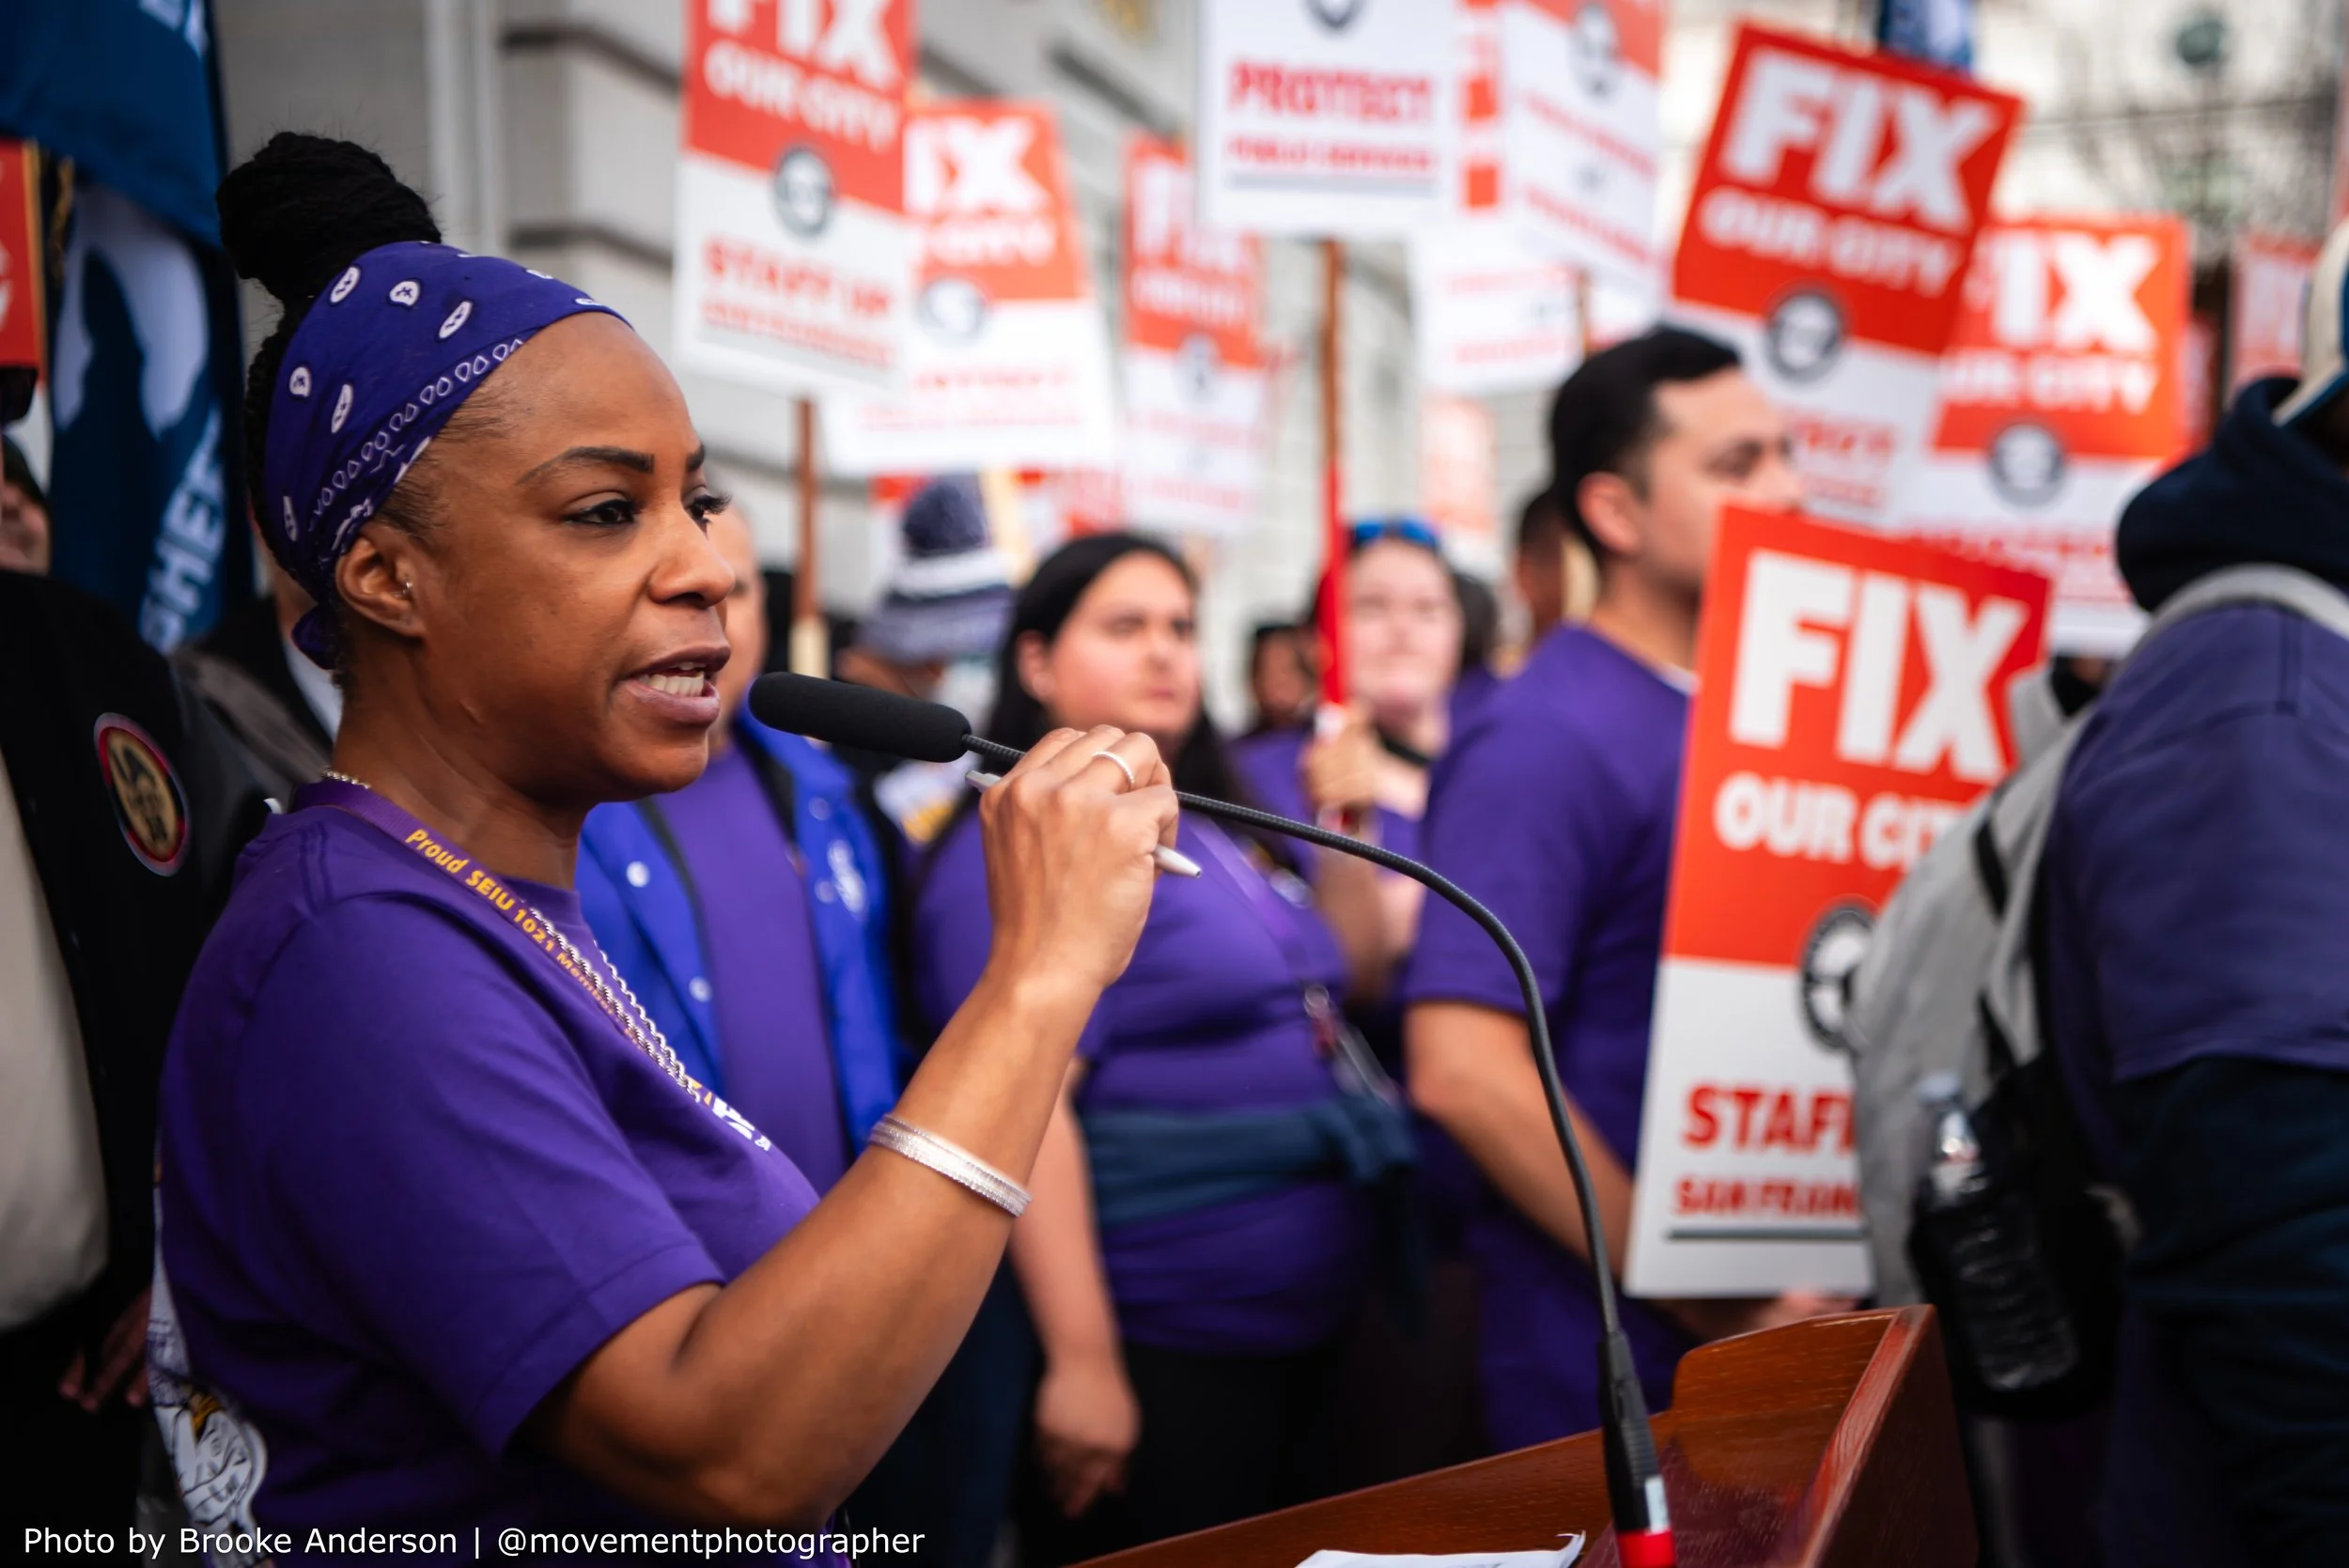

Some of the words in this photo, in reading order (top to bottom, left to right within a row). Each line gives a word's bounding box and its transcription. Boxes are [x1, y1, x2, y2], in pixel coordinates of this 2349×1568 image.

[703, 39, 801, 121] OUR
[801, 74, 899, 154] CITY
[1229, 61, 1431, 123] PROTECT
[1719, 49, 2001, 233] FIX
[903, 115, 1050, 213] IX
[1698, 187, 1830, 267] OUR
[1832, 215, 1960, 296] CITY
[1966, 228, 2159, 350] IX
[1936, 350, 2017, 407] UR
[2028, 353, 2159, 414] CITY
[1731, 548, 2030, 787] FIX
[1714, 771, 1857, 864] OUR
[405, 828, 470, 874] Proud
[465, 869, 516, 911] SEIU
[513, 908, 555, 953] 1021
